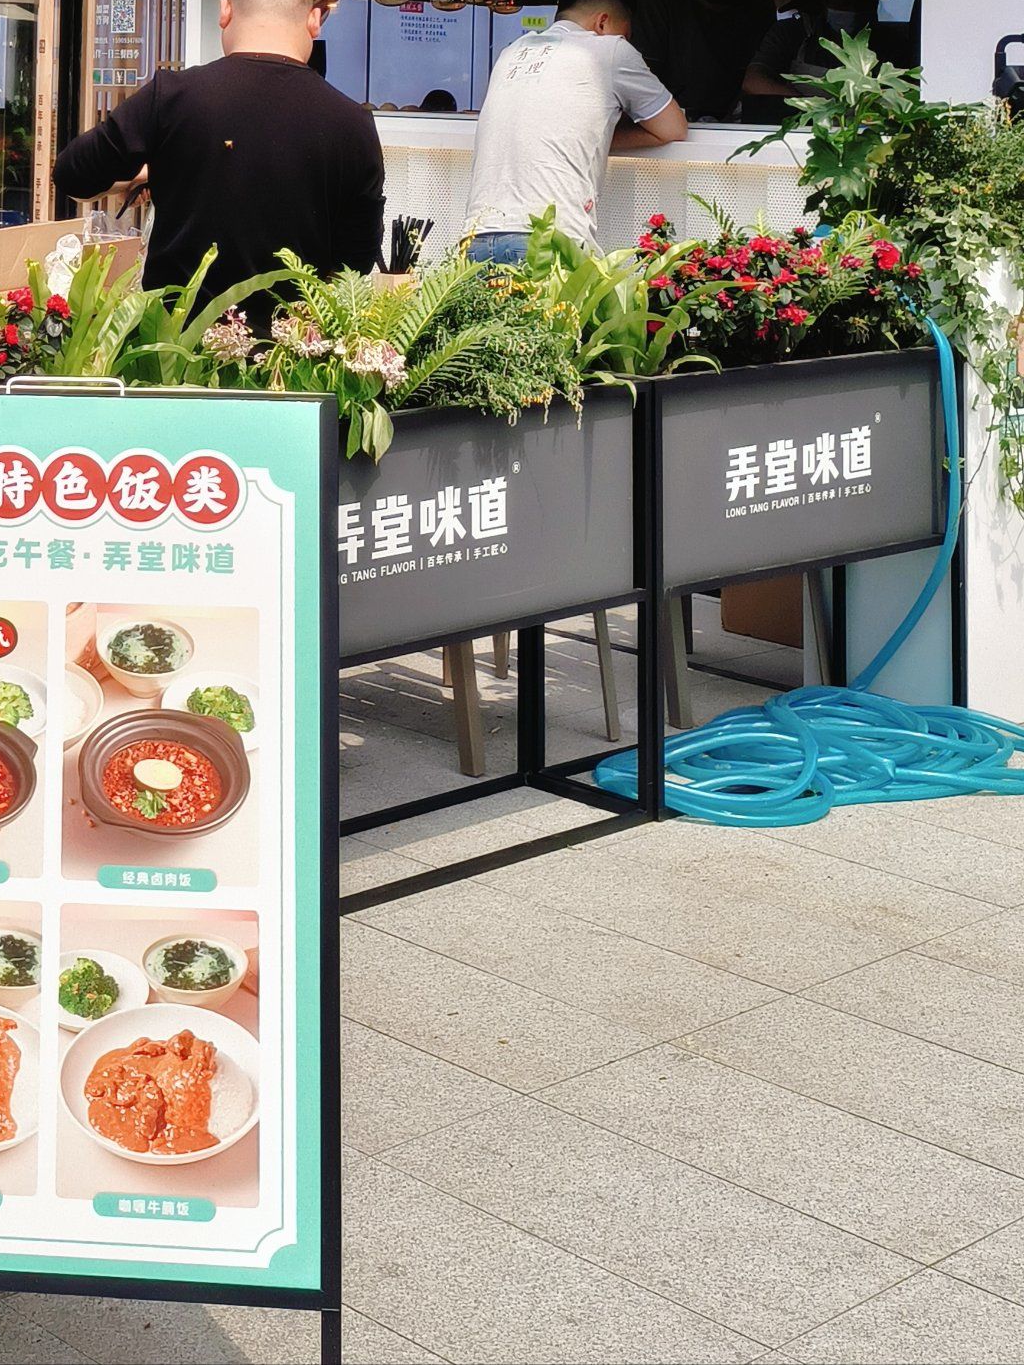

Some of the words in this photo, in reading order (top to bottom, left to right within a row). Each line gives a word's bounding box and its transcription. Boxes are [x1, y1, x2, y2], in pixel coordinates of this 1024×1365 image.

[808, 489, 836, 503] 百年传承
[844, 483, 872, 498] 手工匠心
[726, 506, 747, 519] LONG
[750, 501, 769, 514] TANG
[771, 495, 799, 511] FLAVOR
[427, 550, 462, 569] 百年传承
[473, 543, 508, 560] 手工匠心
[351, 567, 377, 583] TANG
[380, 559, 416, 577] FLAVOR
[122, 870, 192, 887] 经典卤肉饭
[118, 1199, 190, 1216] 咖喱牛腩饭
